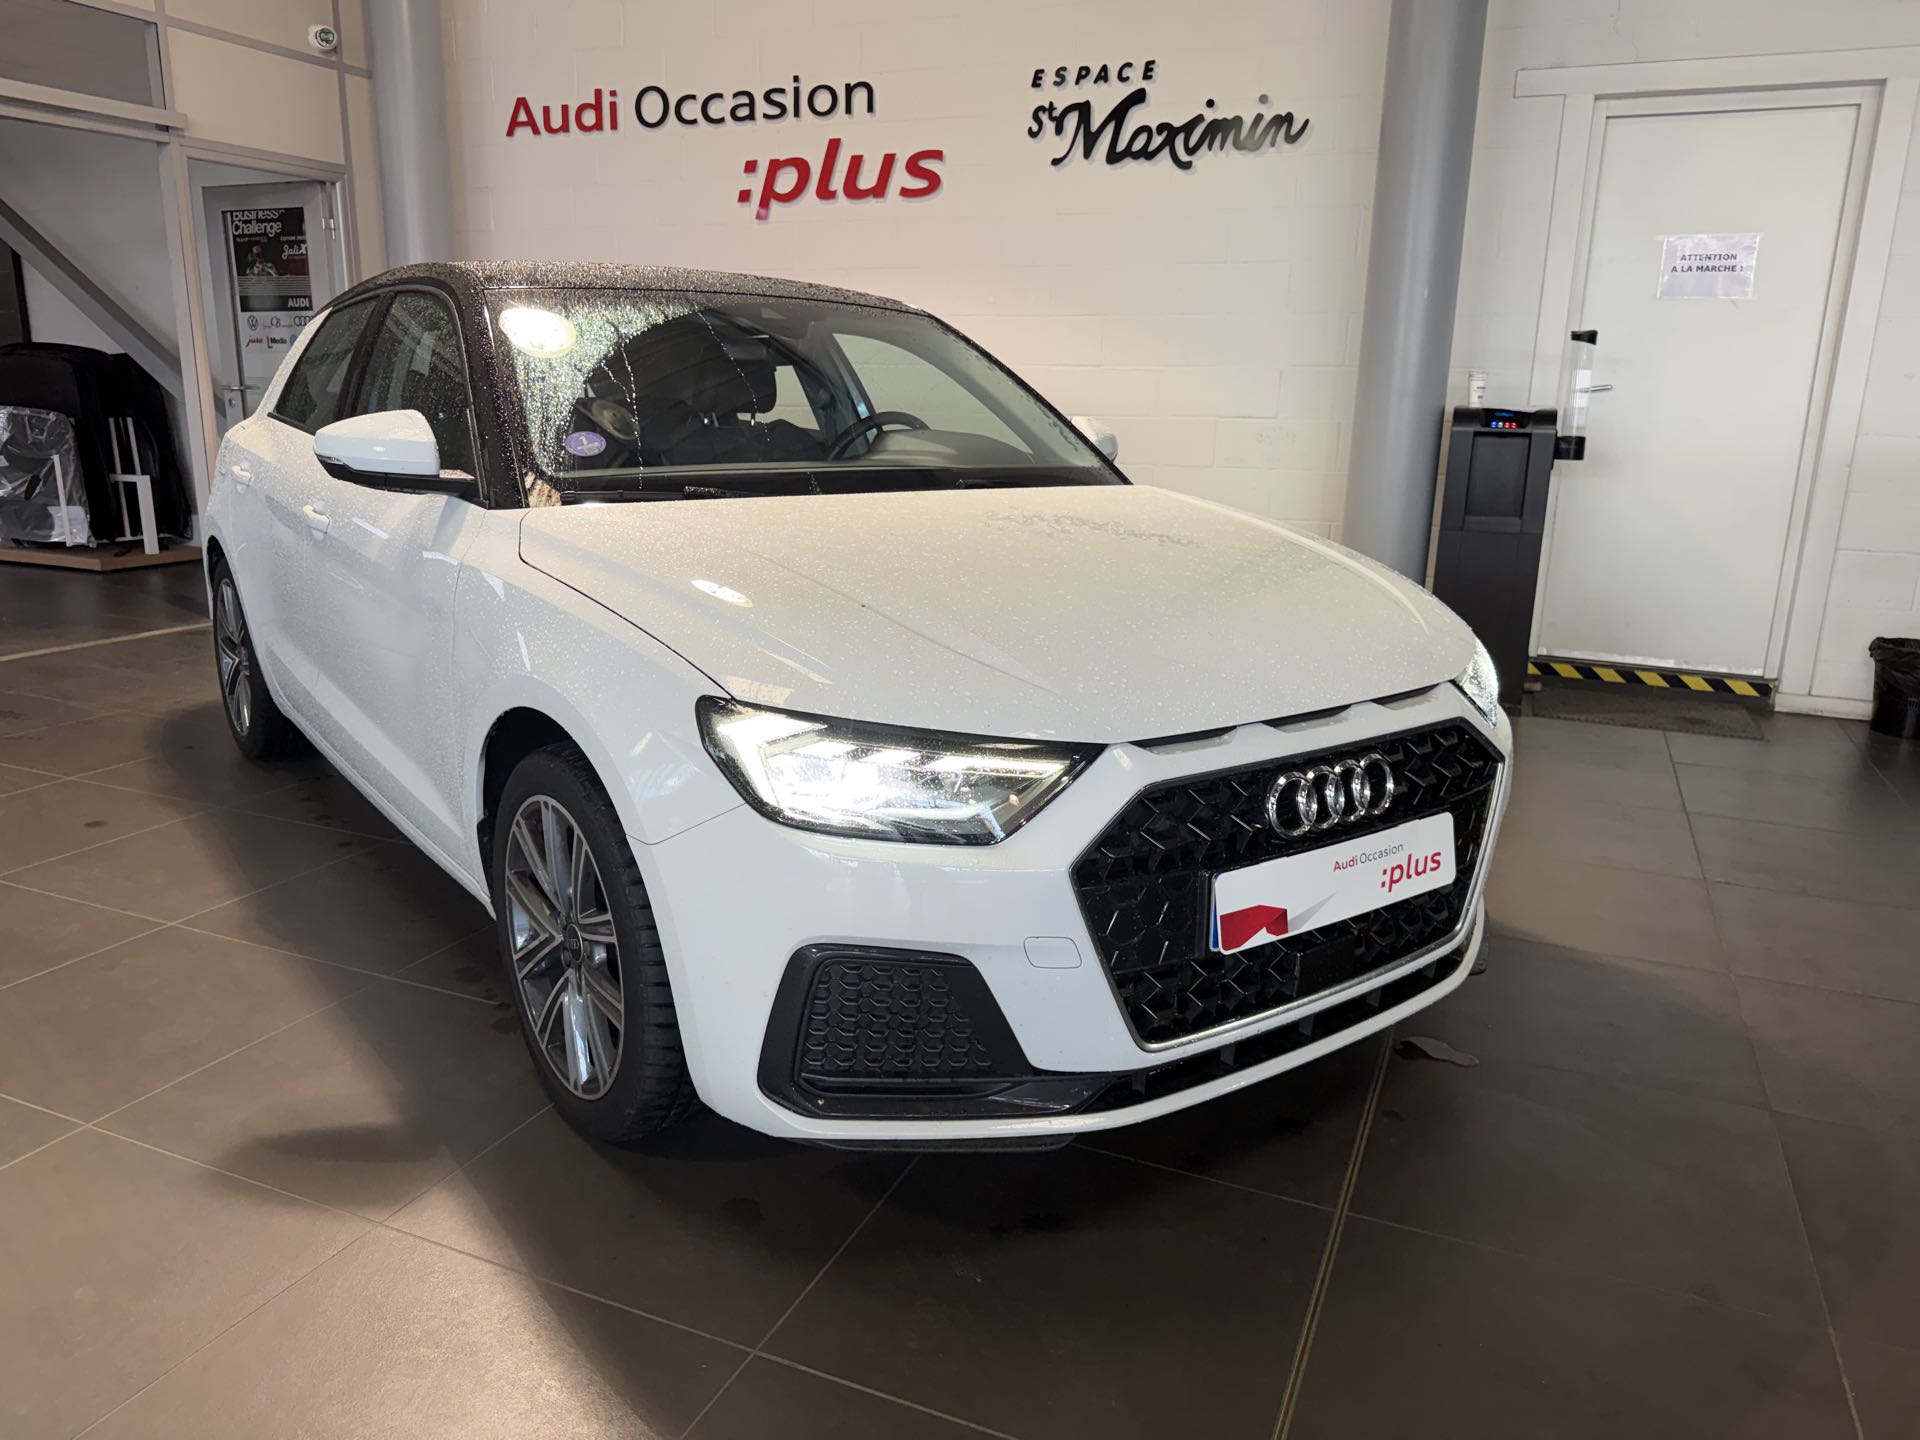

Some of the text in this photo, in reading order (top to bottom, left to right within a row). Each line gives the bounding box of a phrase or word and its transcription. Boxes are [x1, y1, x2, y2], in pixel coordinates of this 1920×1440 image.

[1031, 59, 1156, 88] ESPACE
[505, 75, 875, 137] Audi Occasion
[1027, 87, 1310, 170] St Maximin
[737, 138, 944, 221] :plus
[232, 221, 282, 237] Challenge
[1671, 265, 1678, 273] A
[1681, 265, 1692, 273] LA
[1695, 265, 1737, 273] MARCHE
[1680, 253, 1738, 262] ATTENTION
[287, 297, 310, 308] AUDI
[1333, 842, 1404, 872] Audi Occasion
[1380, 851, 1442, 893] :plus
